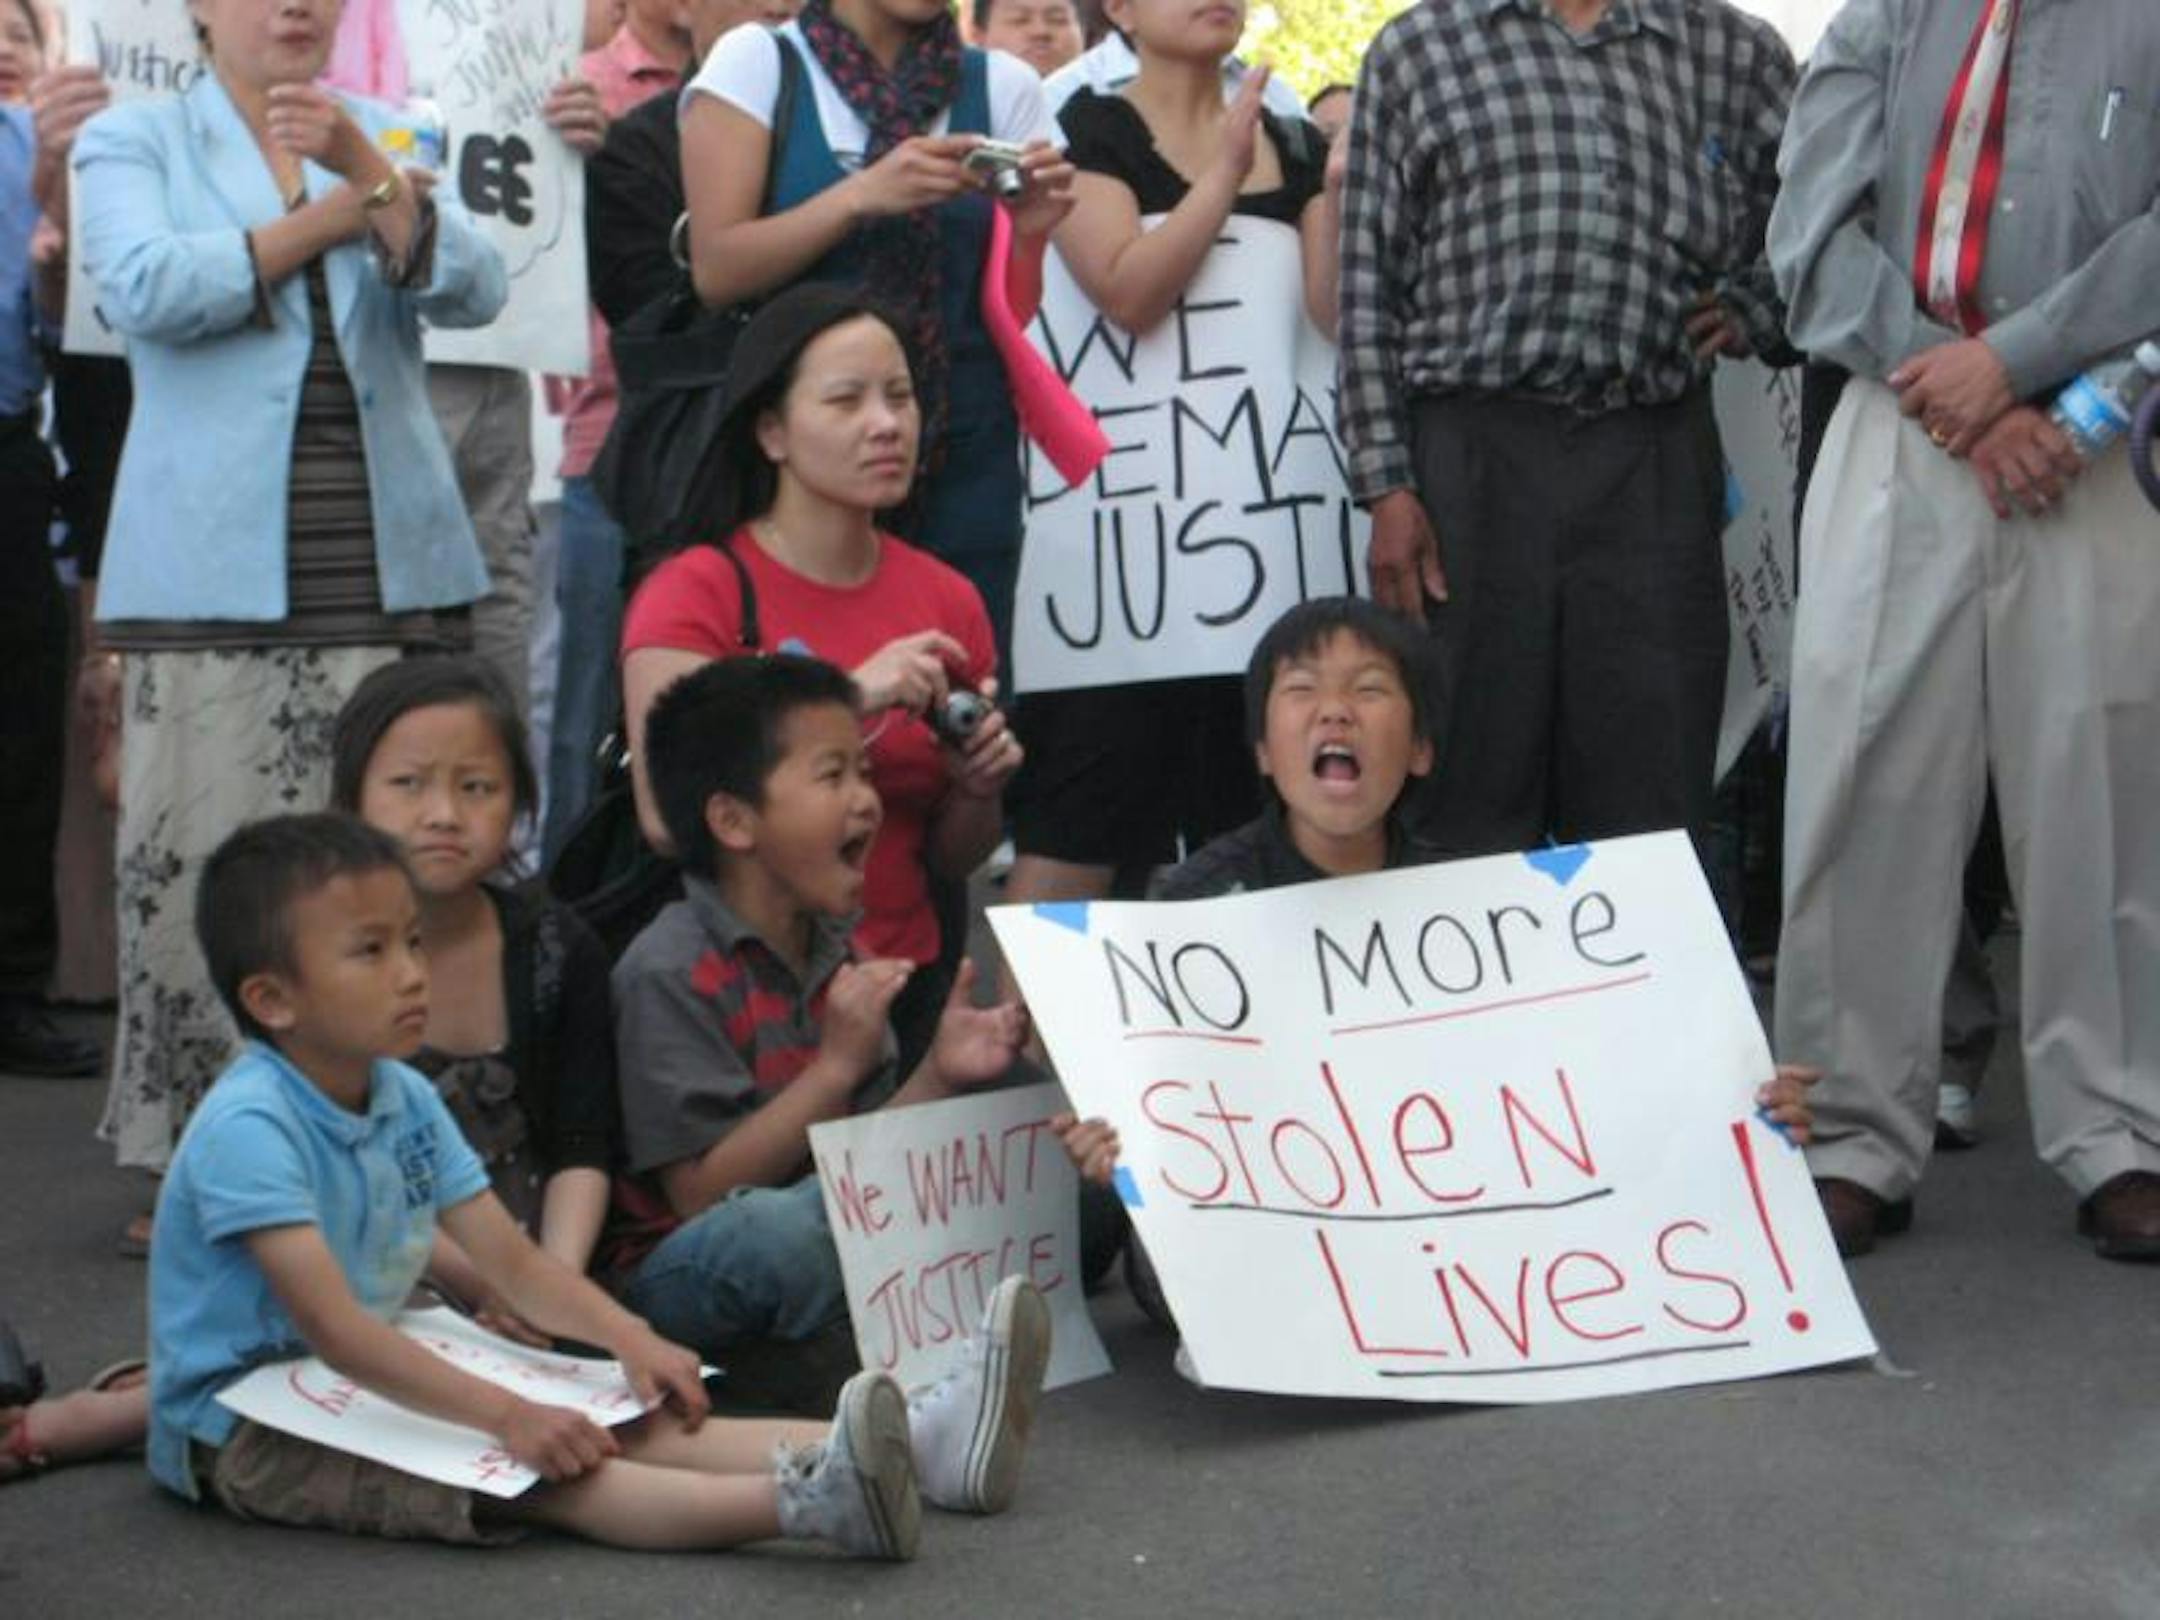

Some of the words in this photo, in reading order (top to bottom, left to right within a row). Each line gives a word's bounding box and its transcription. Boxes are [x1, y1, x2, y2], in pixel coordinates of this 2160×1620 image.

[1037, 238, 1247, 383] WE
[1023, 386, 1352, 512] EMA
[1046, 495, 1357, 650] JUSTI
[1104, 937, 1251, 1032] NO
[821, 1150, 893, 1238] We
[907, 1119, 1052, 1227] WANT
